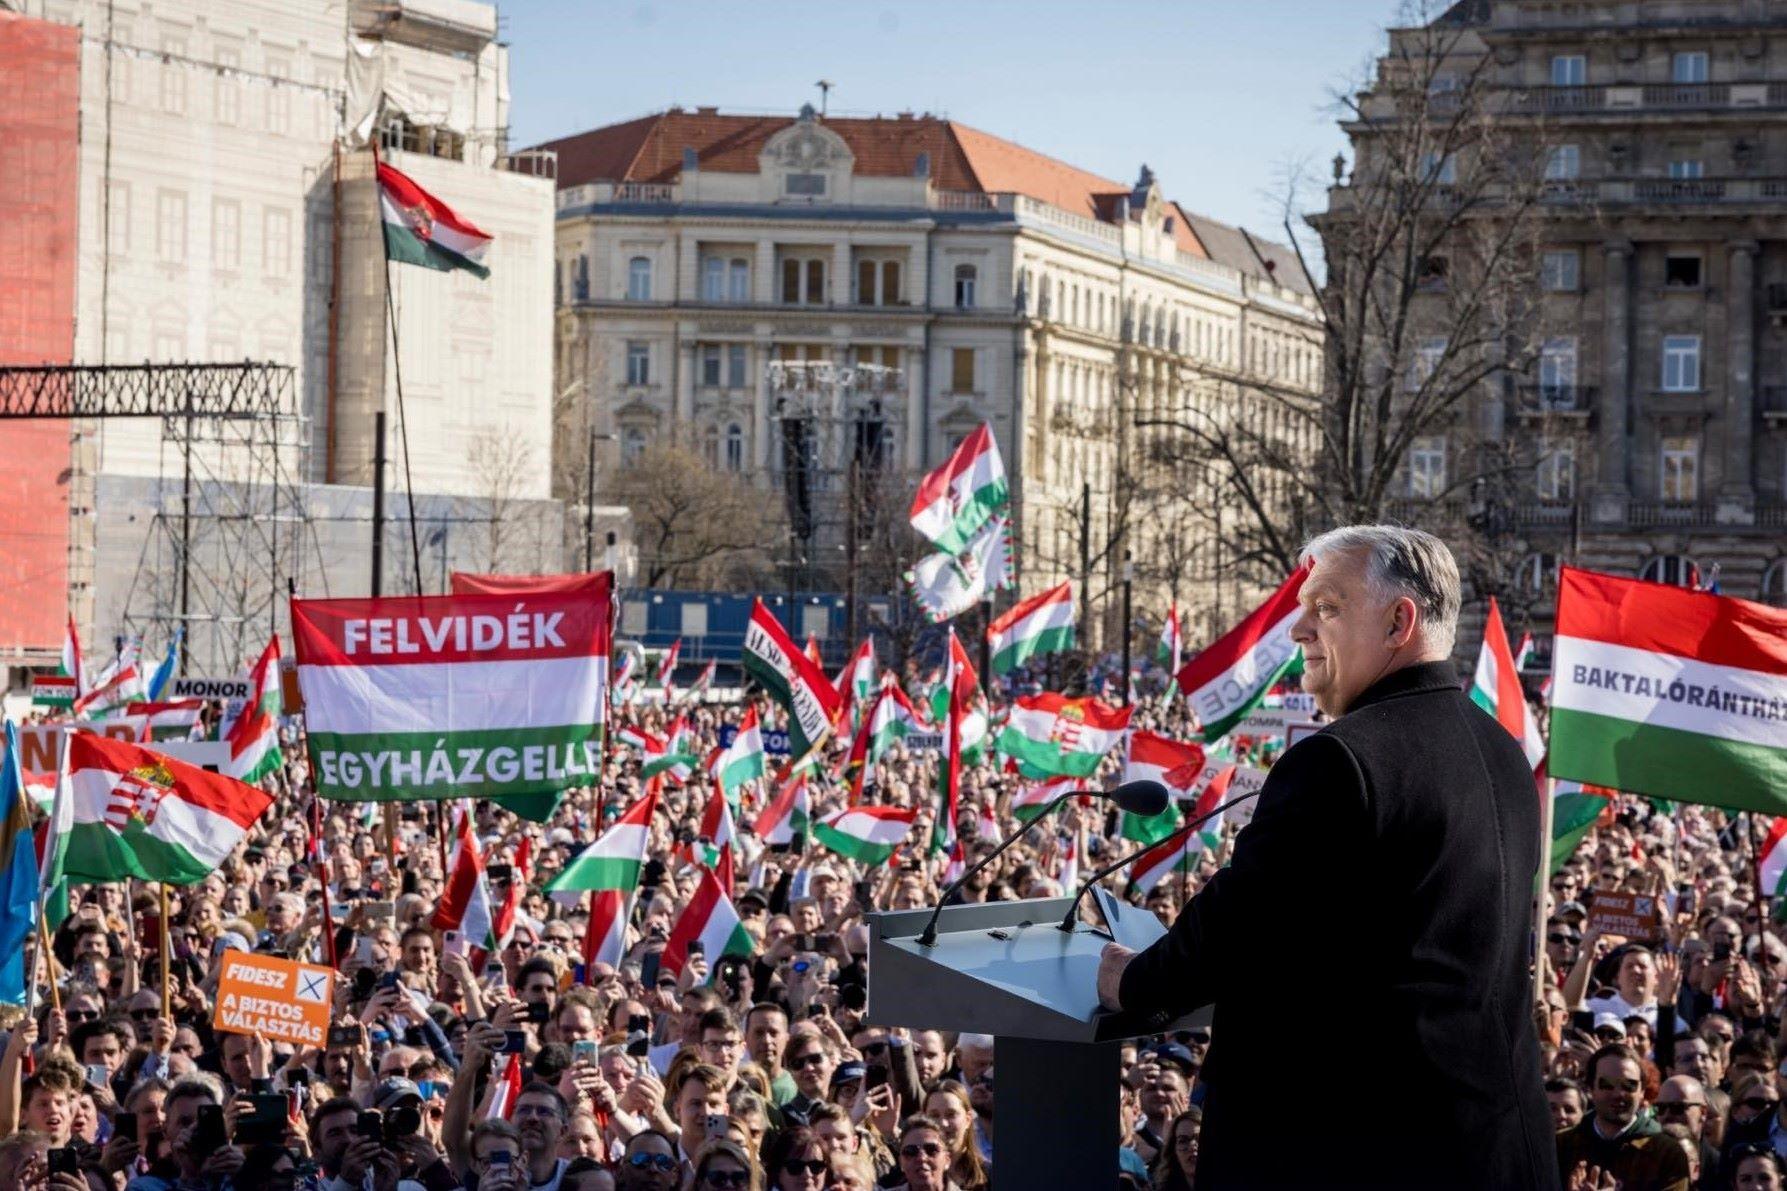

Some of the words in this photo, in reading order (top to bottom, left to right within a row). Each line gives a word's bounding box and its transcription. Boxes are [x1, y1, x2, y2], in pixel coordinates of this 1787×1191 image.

[344, 602, 566, 655] FELVIDÉK
[175, 681, 248, 697] MONOR
[320, 738, 602, 788] EGYHÁZGELLE
[226, 963, 288, 988] FIDESZ
[222, 993, 236, 1009] A
[240, 996, 303, 1020] BIZTOS
[221, 1008, 322, 1041] VÁLASZTÁS
